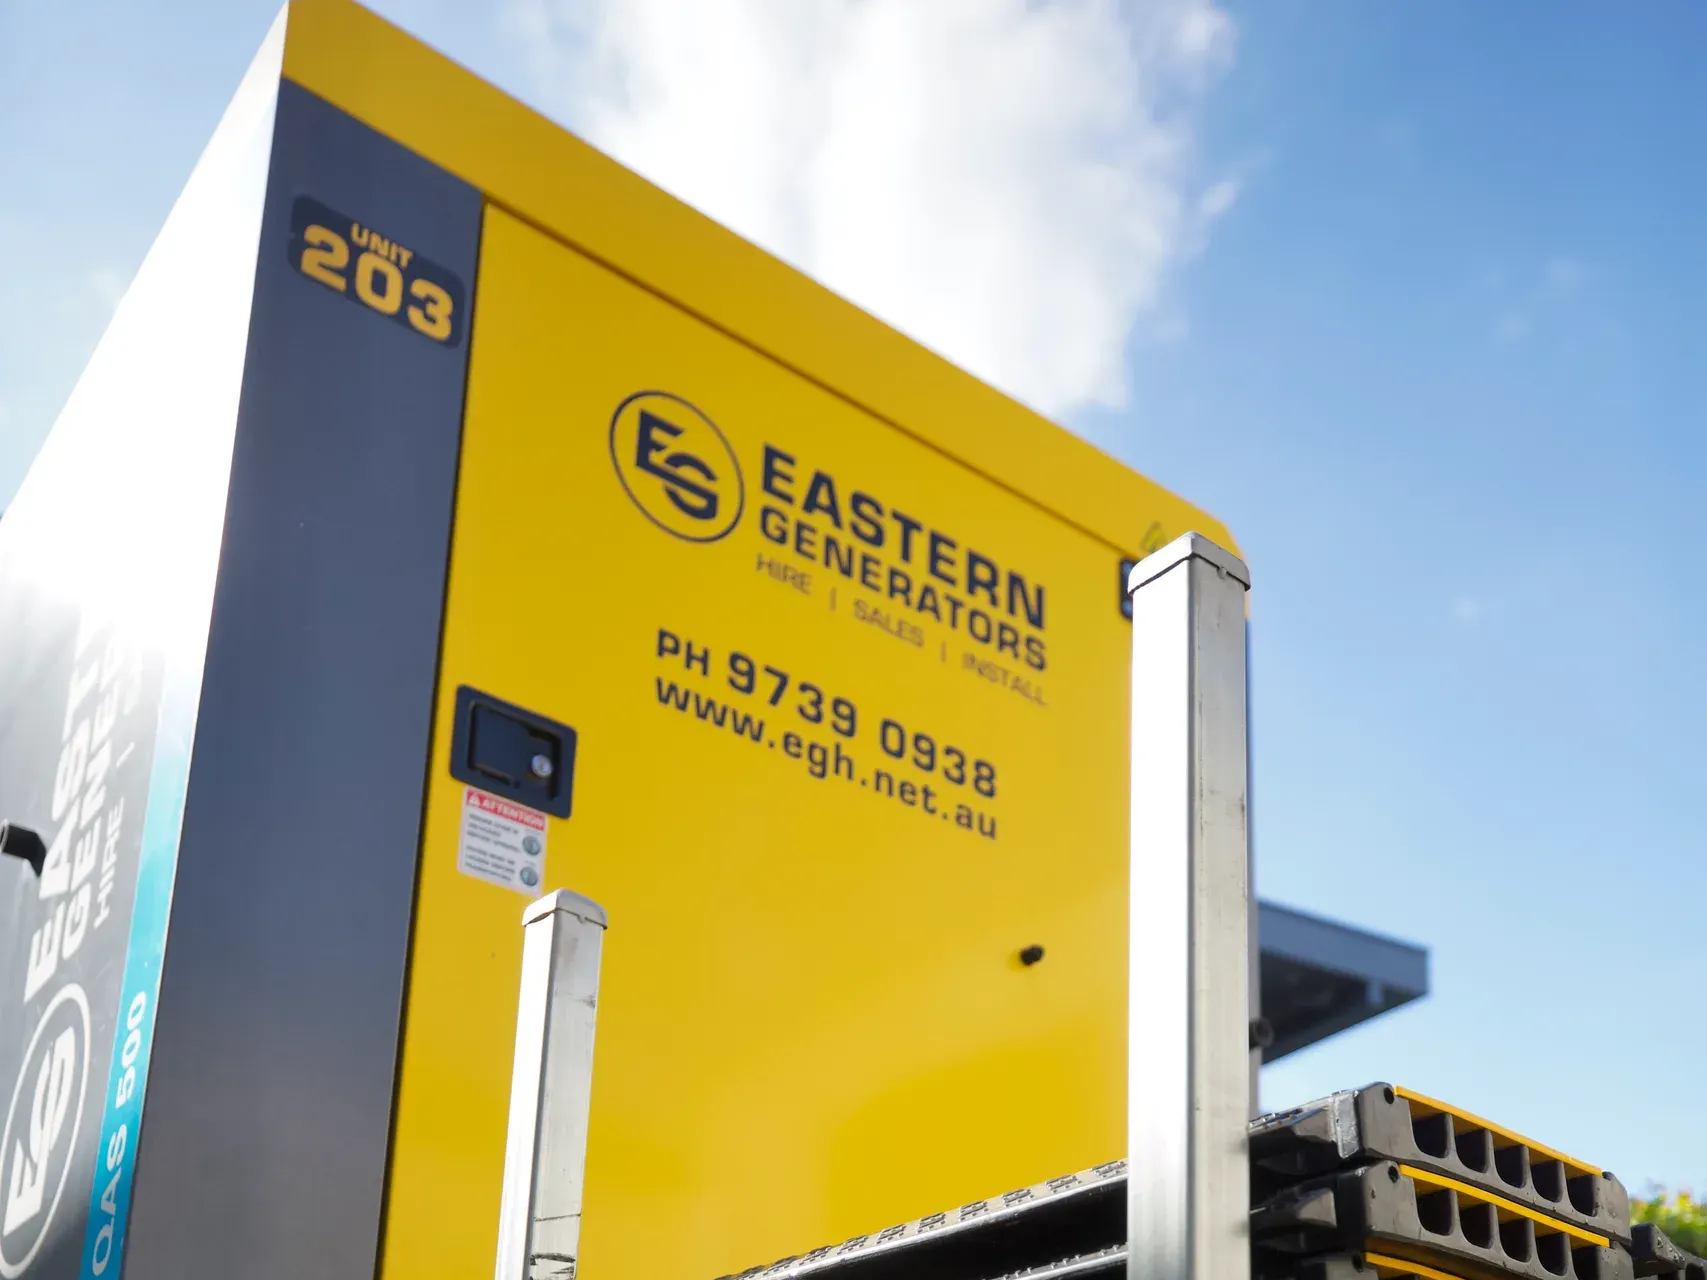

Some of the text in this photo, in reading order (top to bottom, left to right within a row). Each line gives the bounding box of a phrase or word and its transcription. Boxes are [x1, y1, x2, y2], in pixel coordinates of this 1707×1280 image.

[300, 223, 454, 342] 203
[351, 223, 413, 268] UNIT
[759, 504, 1047, 672] GENERATORS
[761, 440, 1046, 631] EASTERN
[756, 552, 813, 597] HIRE
[853, 598, 925, 648] SALES
[961, 651, 1048, 708] INSTALL
[655, 675, 998, 841] www.egh.net.au
[656, 627, 997, 800] PH 9739 0938
[93, 796, 124, 930] HIRE
[92, 990, 147, 1277] QAS 500
